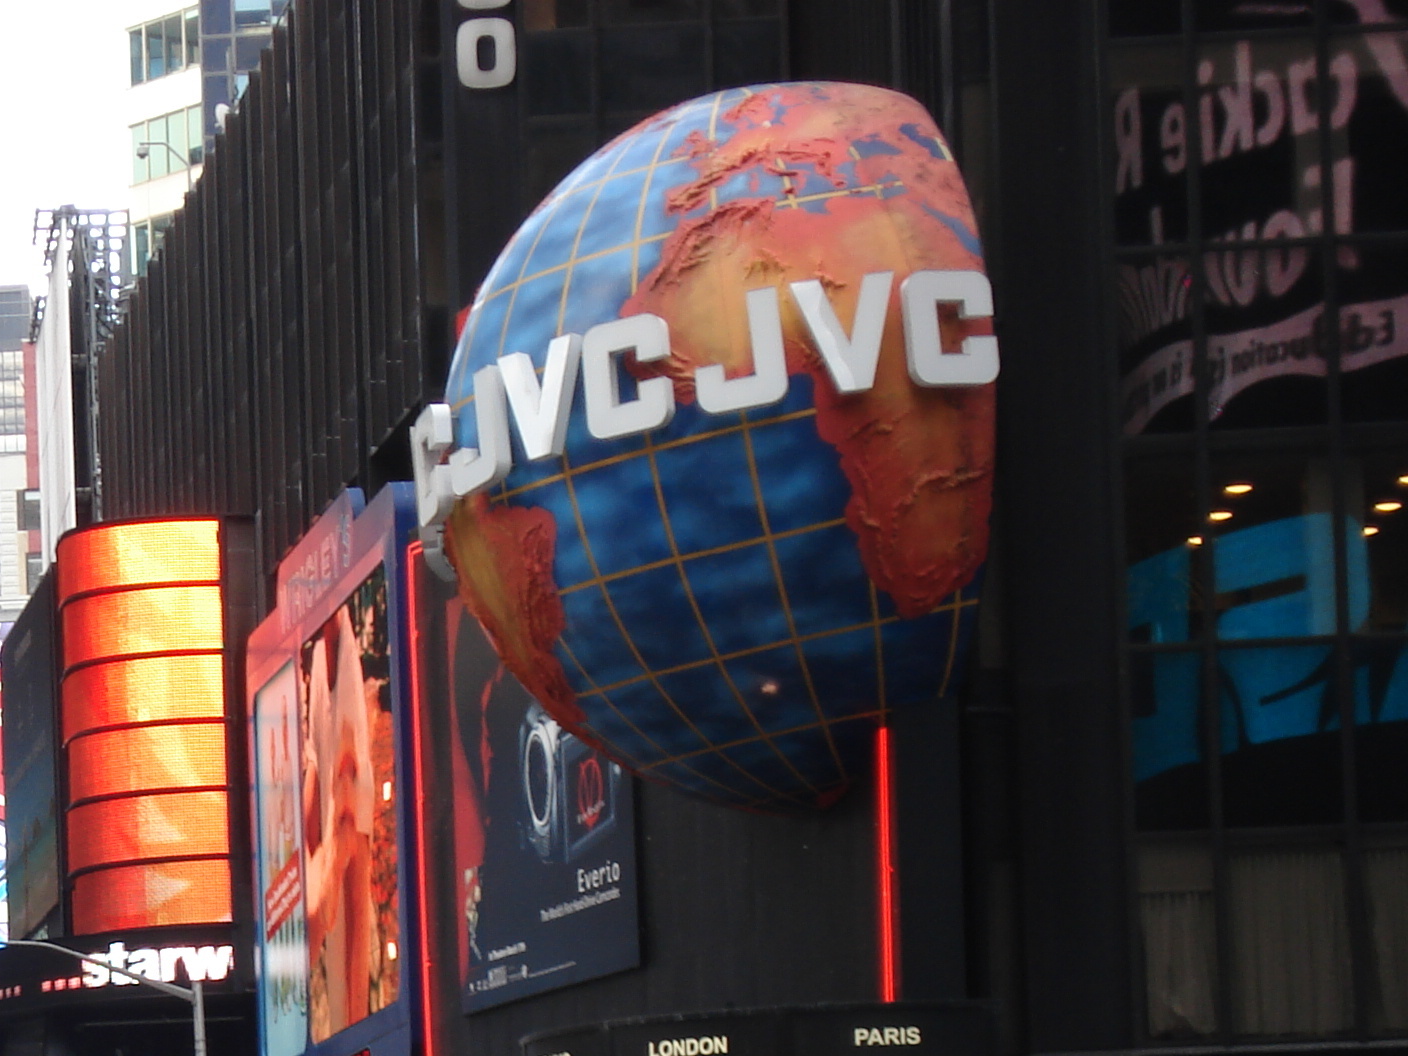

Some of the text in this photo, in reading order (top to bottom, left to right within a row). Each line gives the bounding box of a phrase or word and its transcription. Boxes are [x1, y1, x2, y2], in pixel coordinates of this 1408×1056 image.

[695, 269, 1000, 415] JVC
[451, 313, 676, 497] JVC
[577, 860, 621, 893] Everio
[853, 1026, 922, 1047] PARIS
